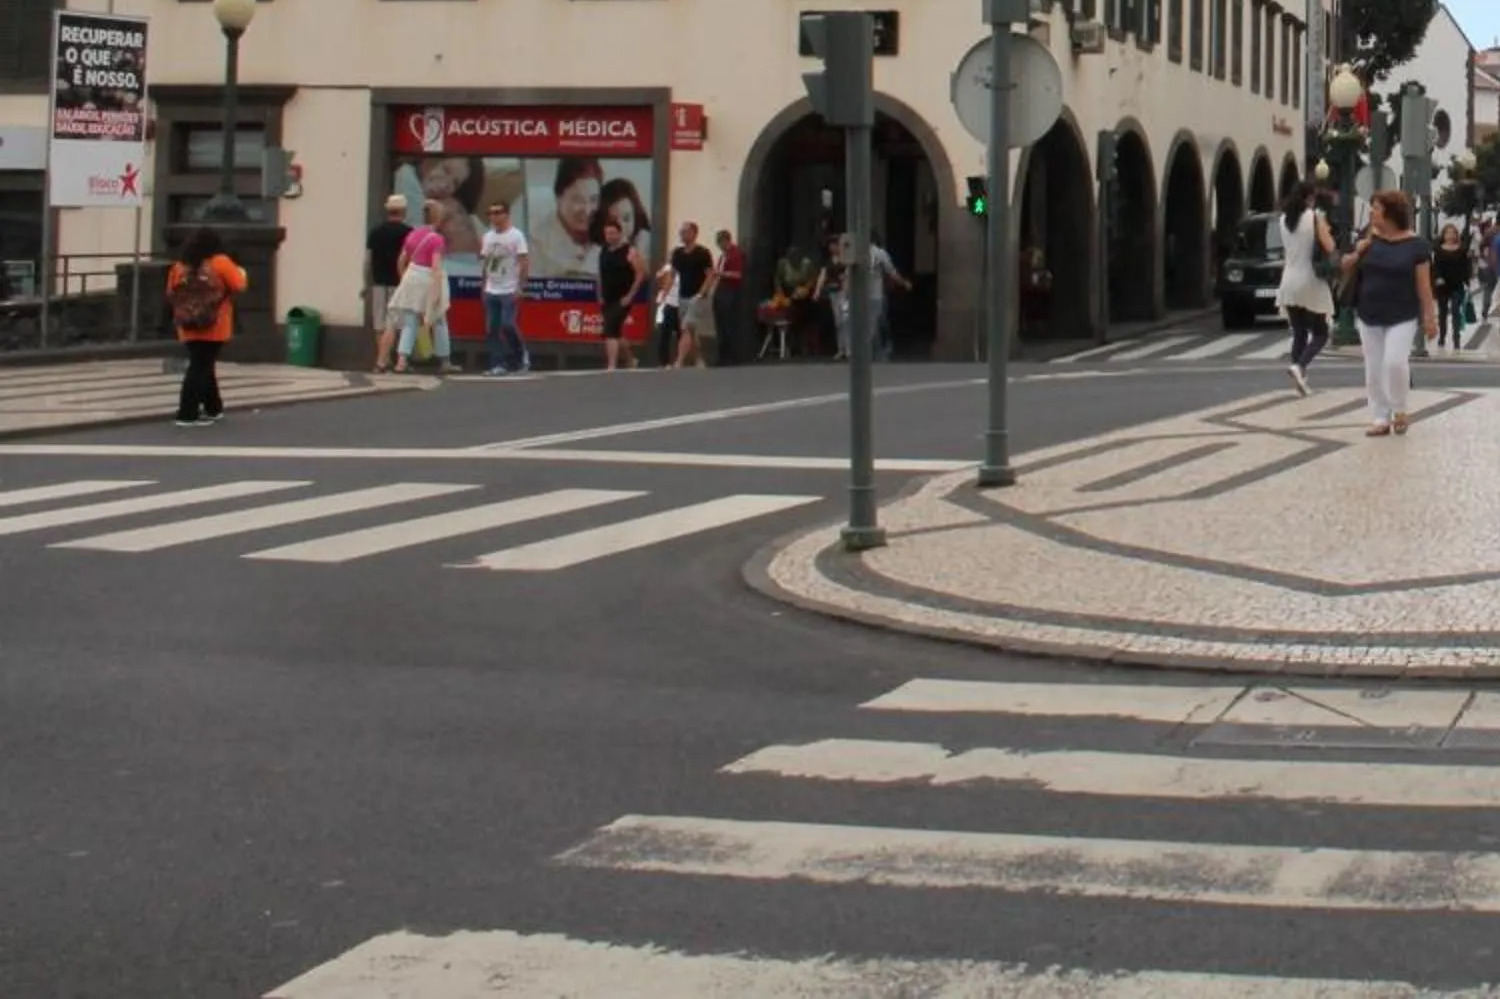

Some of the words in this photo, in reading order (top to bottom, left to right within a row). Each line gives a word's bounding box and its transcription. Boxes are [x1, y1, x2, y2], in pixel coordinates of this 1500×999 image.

[62, 25, 143, 47] RECUPERAR
[65, 47, 78, 64] O
[81, 48, 111, 67] QUE
[73, 65, 83, 86] É
[86, 69, 138, 88] NOSSO.
[447, 116, 548, 136] ACÚSTICA
[559, 116, 637, 137] MÉDICA
